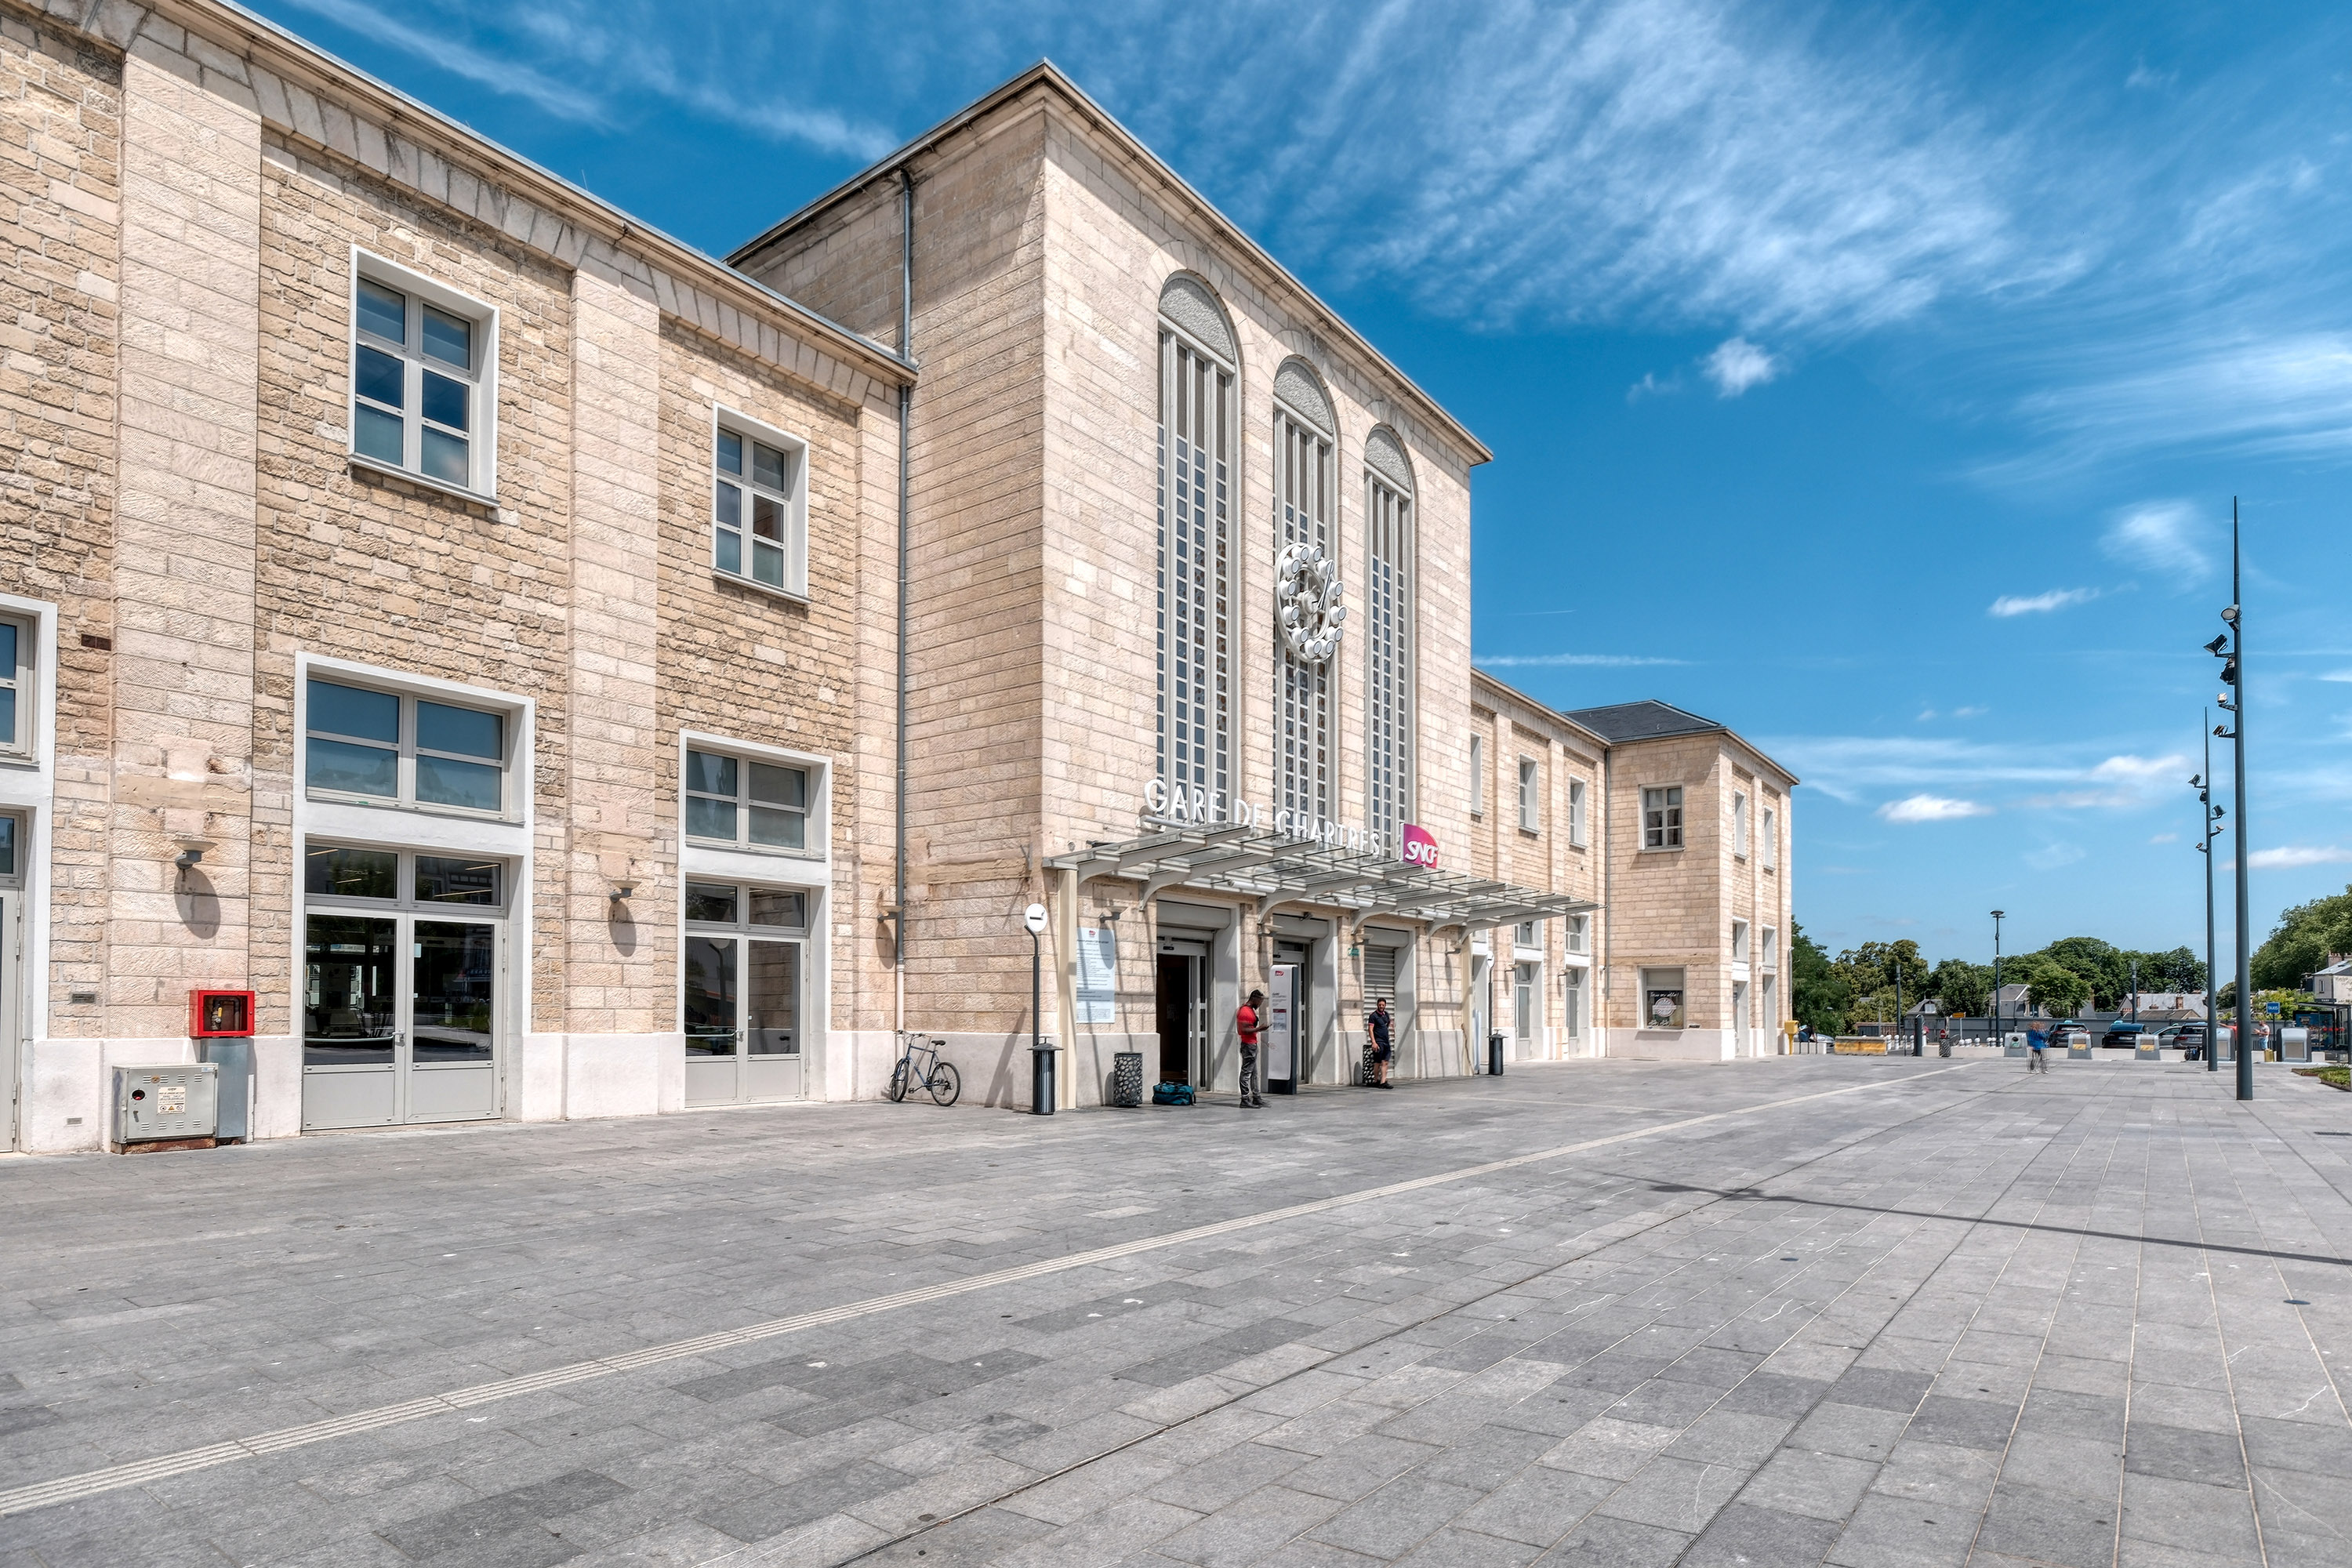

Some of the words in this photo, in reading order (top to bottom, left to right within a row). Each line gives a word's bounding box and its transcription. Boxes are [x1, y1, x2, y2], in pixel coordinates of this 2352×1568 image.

[1144, 779, 1221, 826] GARE
[1233, 798, 1264, 828] DE
[1276, 810, 1380, 855] CHARTRES
[1405, 840, 1439, 864] SNCF
